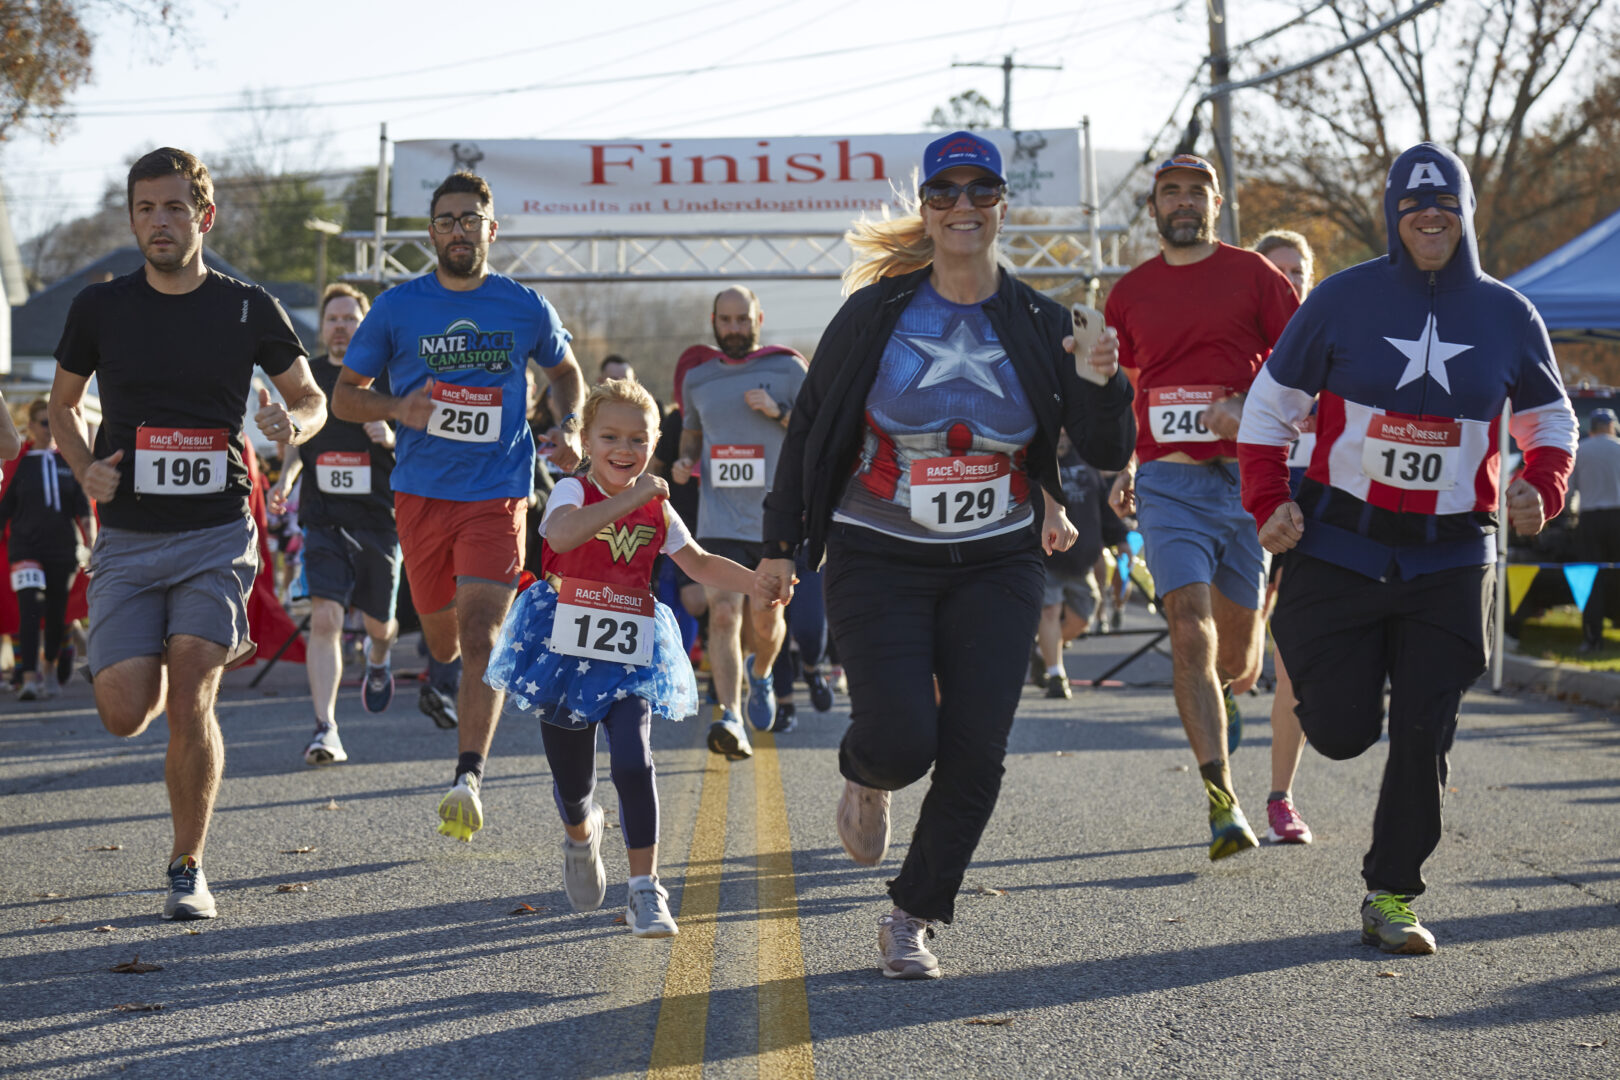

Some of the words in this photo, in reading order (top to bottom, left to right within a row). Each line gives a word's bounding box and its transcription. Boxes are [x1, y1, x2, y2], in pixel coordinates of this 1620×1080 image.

[580, 140, 889, 186] Finish
[1406, 161, 1448, 189] A
[523, 199, 619, 213] Results
[629, 200, 652, 212] at
[429, 350, 507, 366] CANASTOTA
[442, 389, 460, 399] RACE
[469, 393, 493, 401] RESULT
[440, 408, 489, 436] 250
[150, 435, 173, 445] RACE
[183, 436, 214, 446] RESULT
[1381, 423, 1406, 436] RACE
[1416, 429, 1449, 440] RESULT
[152, 457, 211, 486] 196
[719, 463, 754, 481] 200
[927, 466, 953, 477] RACE
[965, 462, 999, 475] RESULT
[1381, 448, 1443, 483] 130
[331, 470, 353, 488] 85
[931, 487, 995, 525] 129
[575, 588, 601, 601] RACE
[613, 594, 643, 607] RESULT
[574, 614, 639, 655] 123
